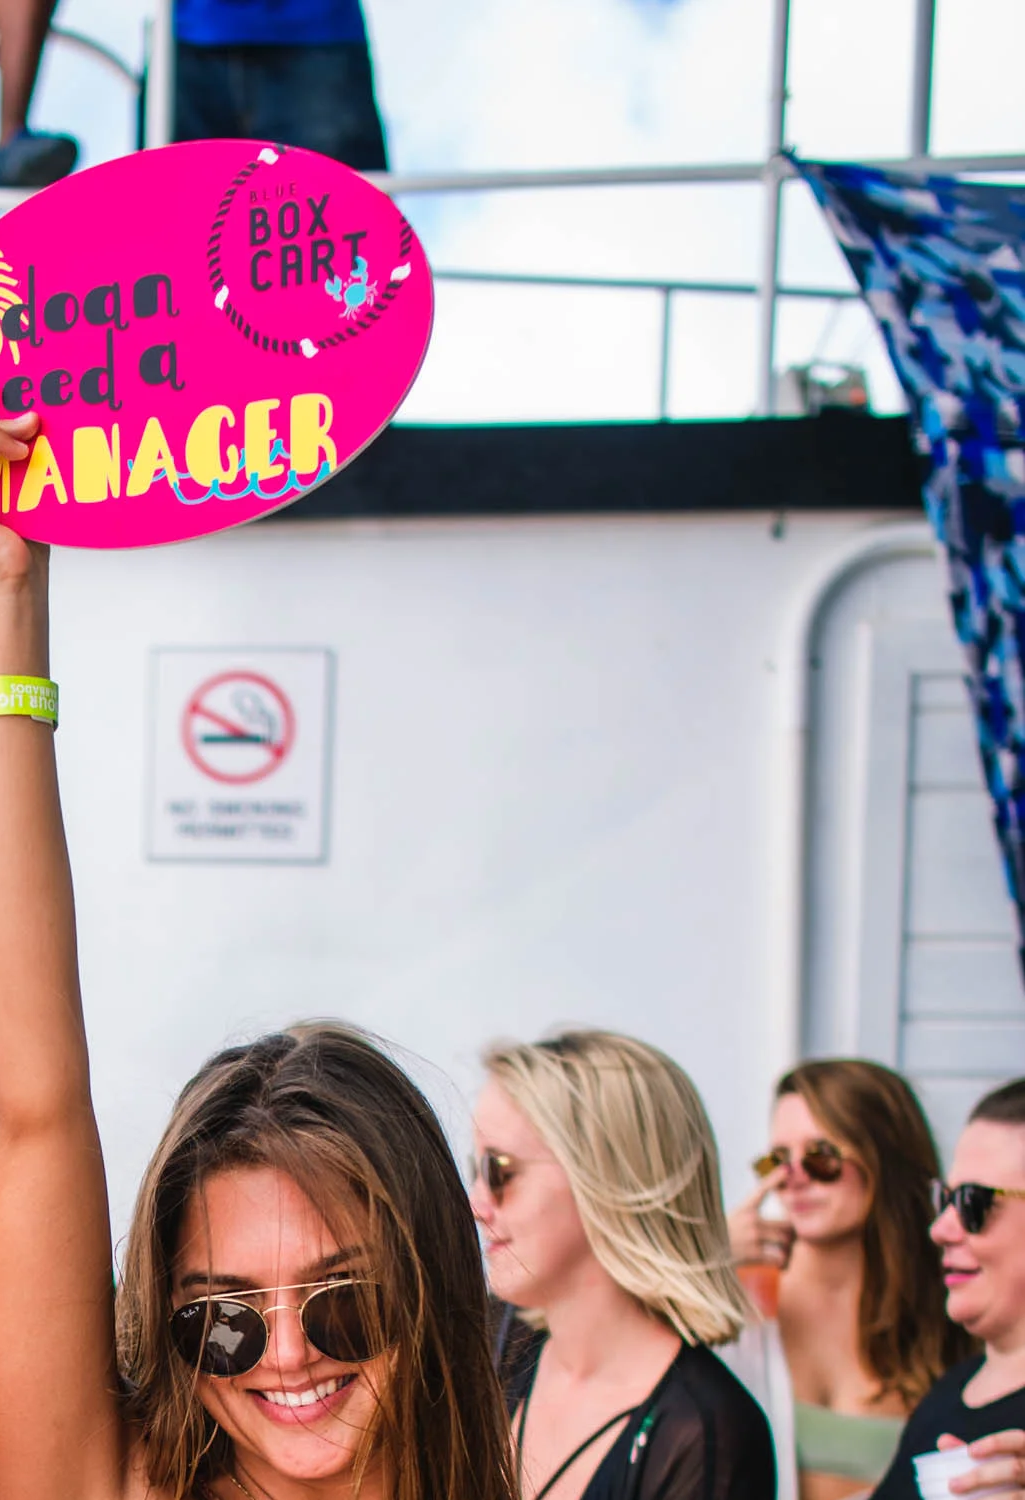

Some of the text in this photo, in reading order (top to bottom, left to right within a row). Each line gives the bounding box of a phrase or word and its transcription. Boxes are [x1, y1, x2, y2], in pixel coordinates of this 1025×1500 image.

[250, 182, 296, 202] BLUE
[250, 193, 330, 247] BOX
[250, 231, 368, 292] CART
[2, 265, 180, 347] doan
[139, 341, 186, 390] a
